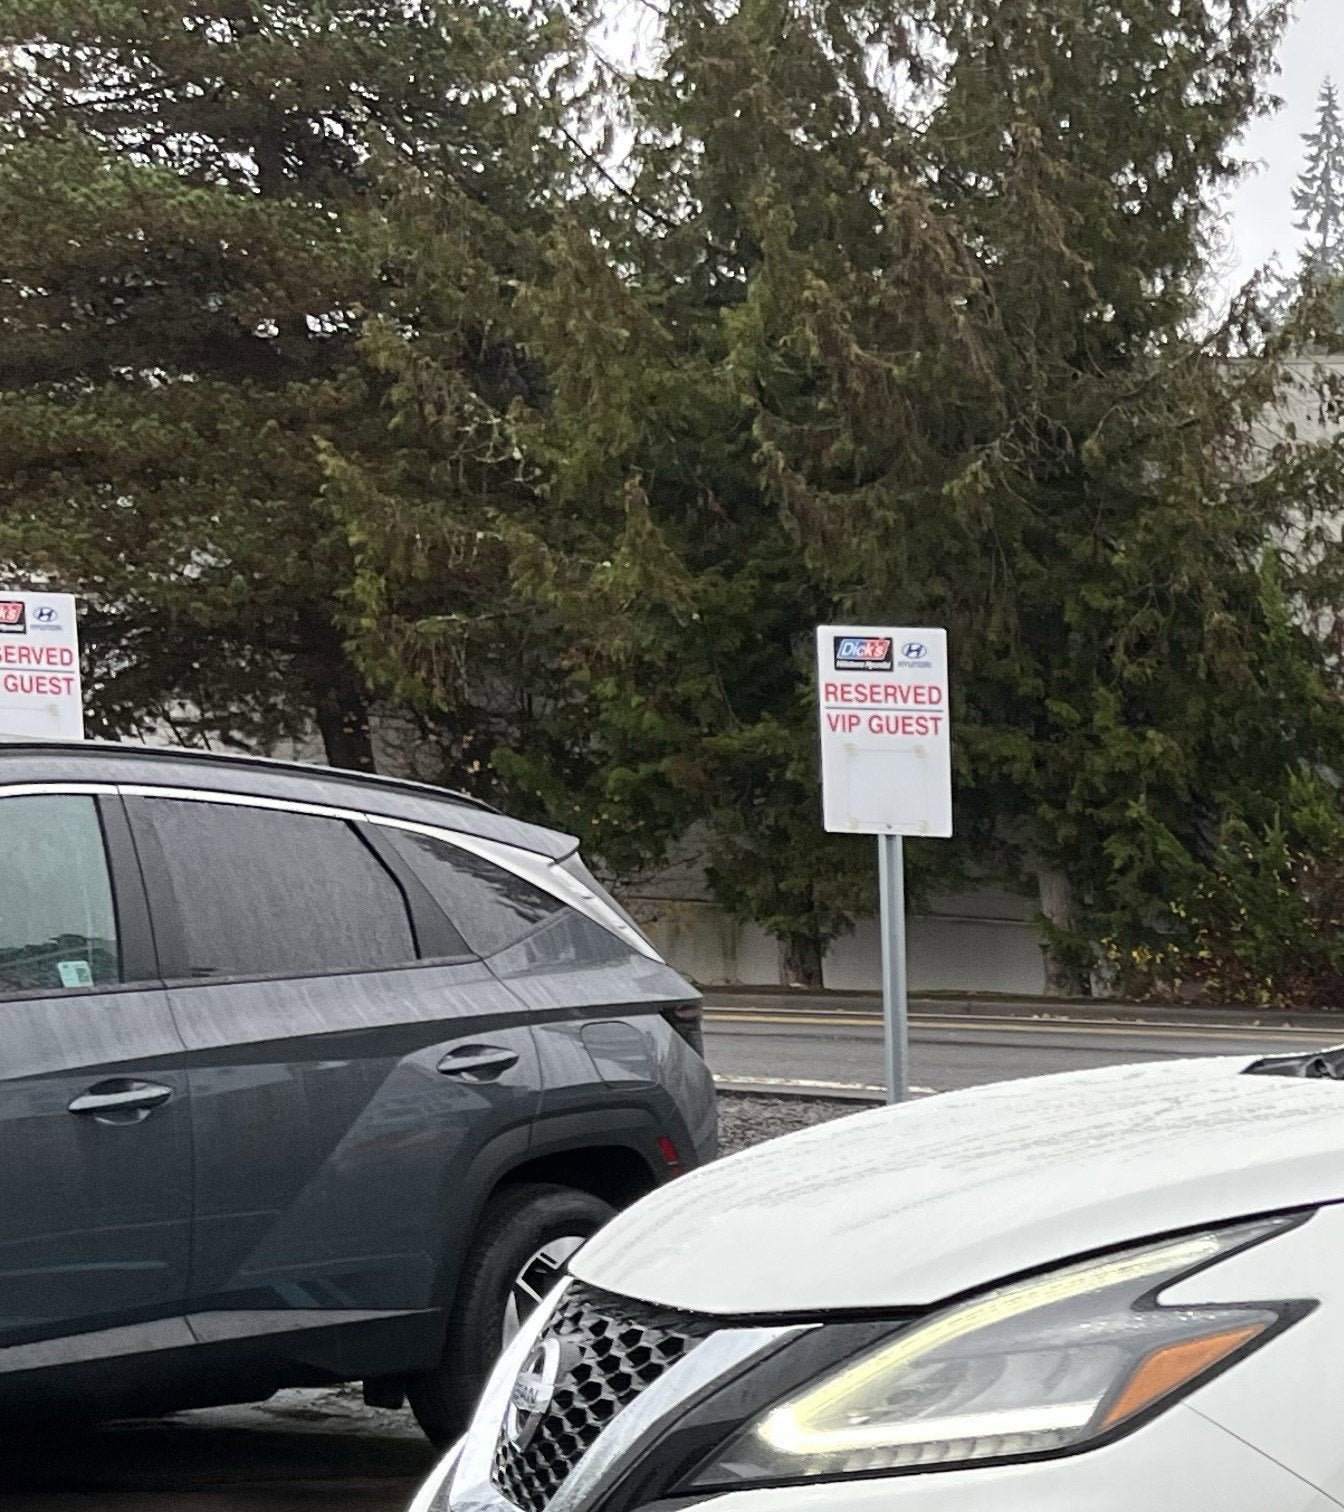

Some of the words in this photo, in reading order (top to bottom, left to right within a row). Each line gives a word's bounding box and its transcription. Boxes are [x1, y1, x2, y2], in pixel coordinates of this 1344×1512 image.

[0, 644, 73, 666] ERVED
[4, 673, 75, 696] GUEST
[824, 682, 942, 706] RESERVED
[826, 713, 861, 733] VIP
[868, 714, 943, 736] GUEST
